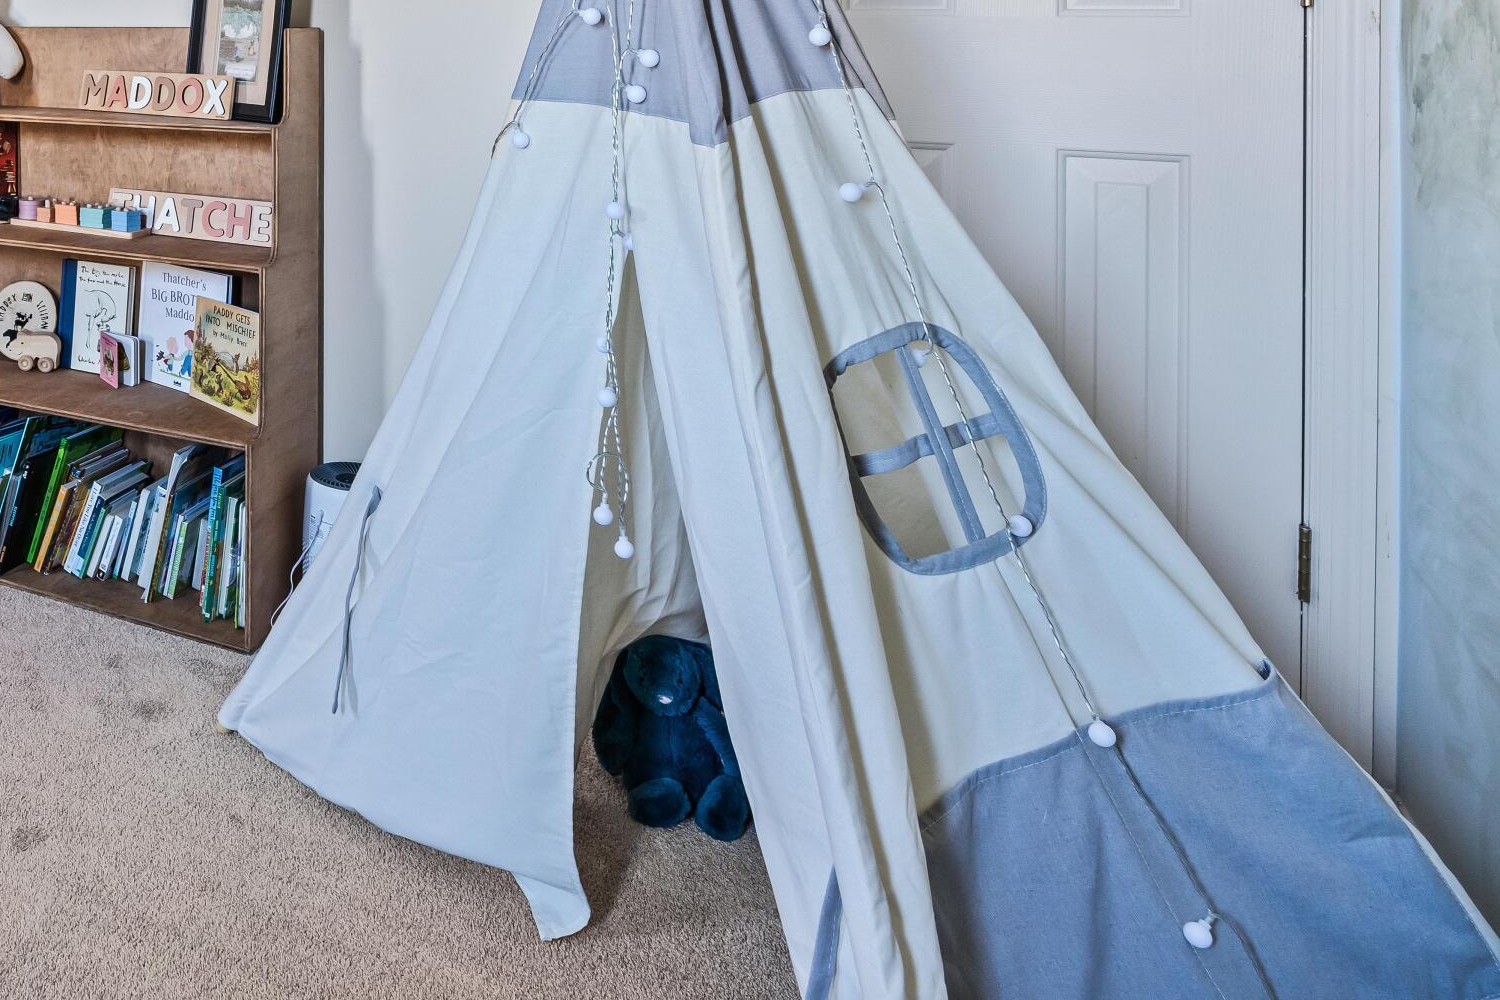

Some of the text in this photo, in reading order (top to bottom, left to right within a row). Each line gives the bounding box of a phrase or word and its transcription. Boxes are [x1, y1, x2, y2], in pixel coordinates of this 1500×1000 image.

[83, 73, 228, 116] MADDOX
[162, 271, 207, 292] Thatcher's
[151, 288, 168, 303] BIG
[213, 305, 251, 326] PADDY GETS
[205, 314, 256, 340] INTO MISCHIEF
